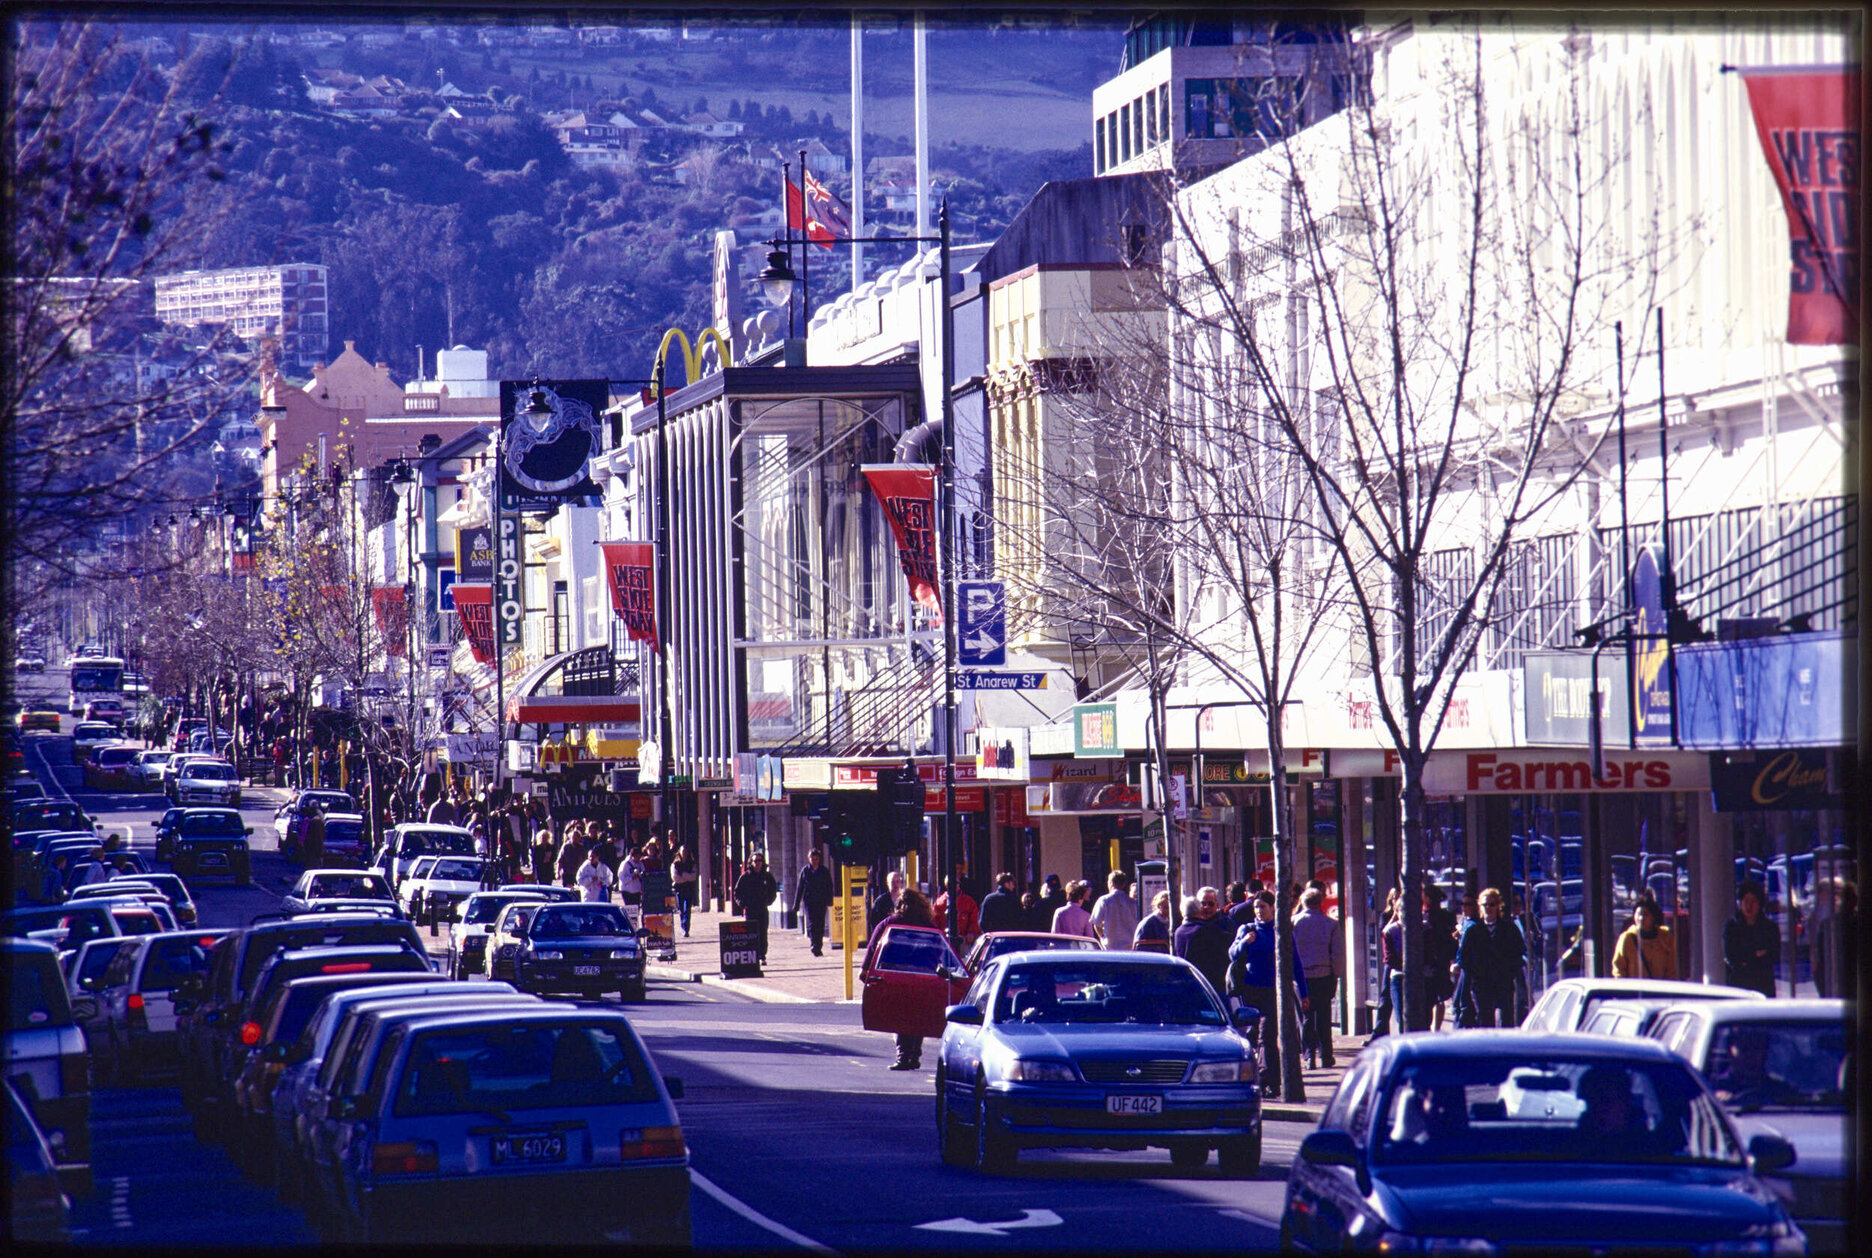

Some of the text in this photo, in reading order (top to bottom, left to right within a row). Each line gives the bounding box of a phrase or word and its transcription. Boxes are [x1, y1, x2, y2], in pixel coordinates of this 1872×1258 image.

[883, 497, 931, 529] WEST
[500, 518, 521, 641] PHOTOS
[613, 565, 650, 589] WEST
[618, 587, 652, 610] SIDE
[967, 589, 995, 624] P
[459, 603, 490, 621] WEST
[957, 674, 1036, 688] St Andrew St
[1052, 763, 1097, 782] Wizard
[1466, 752, 1672, 791] Farmers
[551, 788, 622, 810] ANTIQUES
[723, 950, 757, 965] OPEN
[1112, 1097, 1157, 1112] UF442
[523, 1137, 562, 1158] 6029
